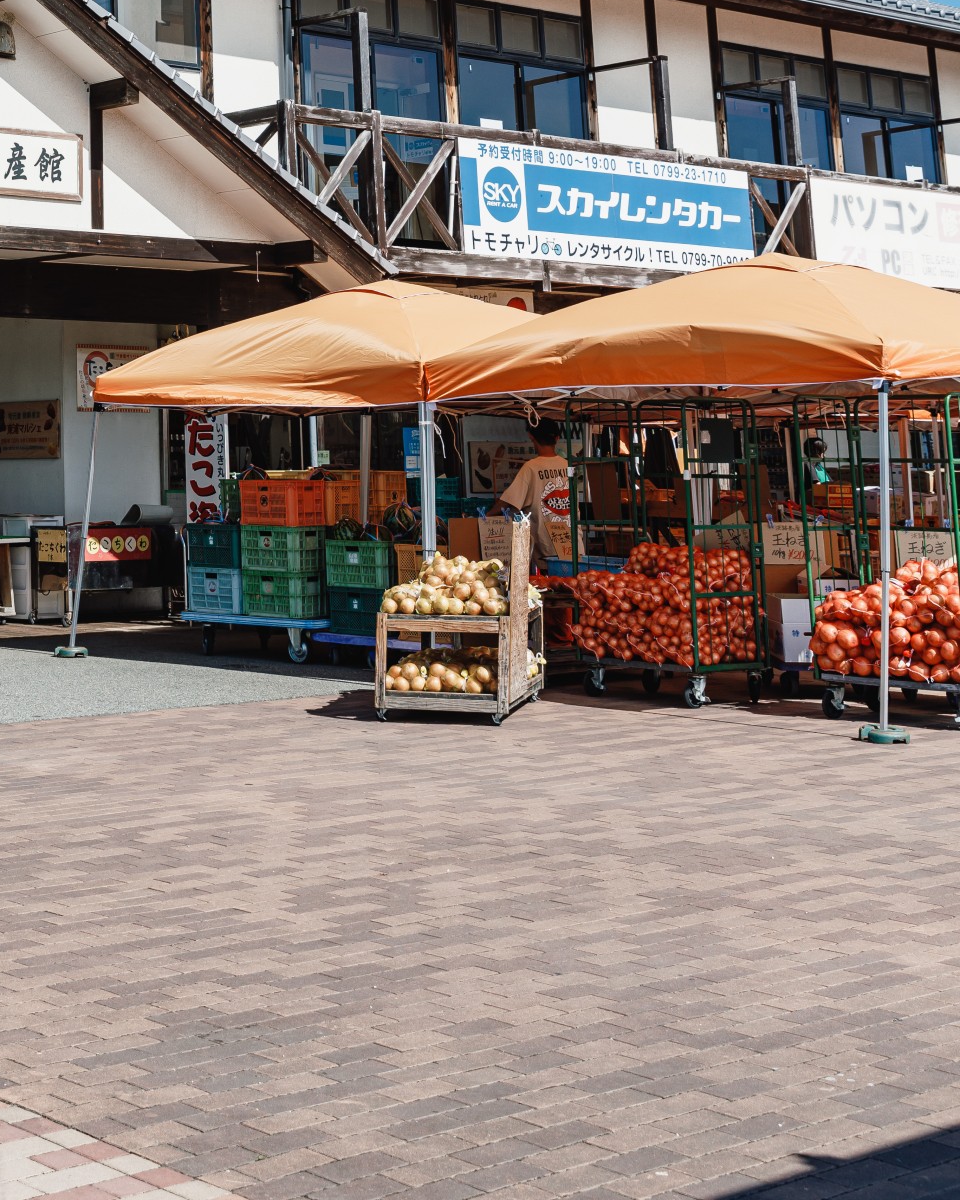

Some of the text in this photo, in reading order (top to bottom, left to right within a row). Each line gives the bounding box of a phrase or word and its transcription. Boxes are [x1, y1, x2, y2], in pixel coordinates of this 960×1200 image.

[477, 143, 544, 164] 予約受付時間
[627, 161, 649, 176] TEL
[653, 163, 726, 185] 0799-23-1710
[483, 181, 520, 201] SKY
[537, 183, 742, 231] スカイレンタカー
[830, 194, 929, 235] パソコン
[471, 230, 539, 255] トモチャリ
[658, 250, 678, 265] TEL
[681, 252, 750, 267] 0799-70-90
[87, 538, 147, 550] たこちくわ
